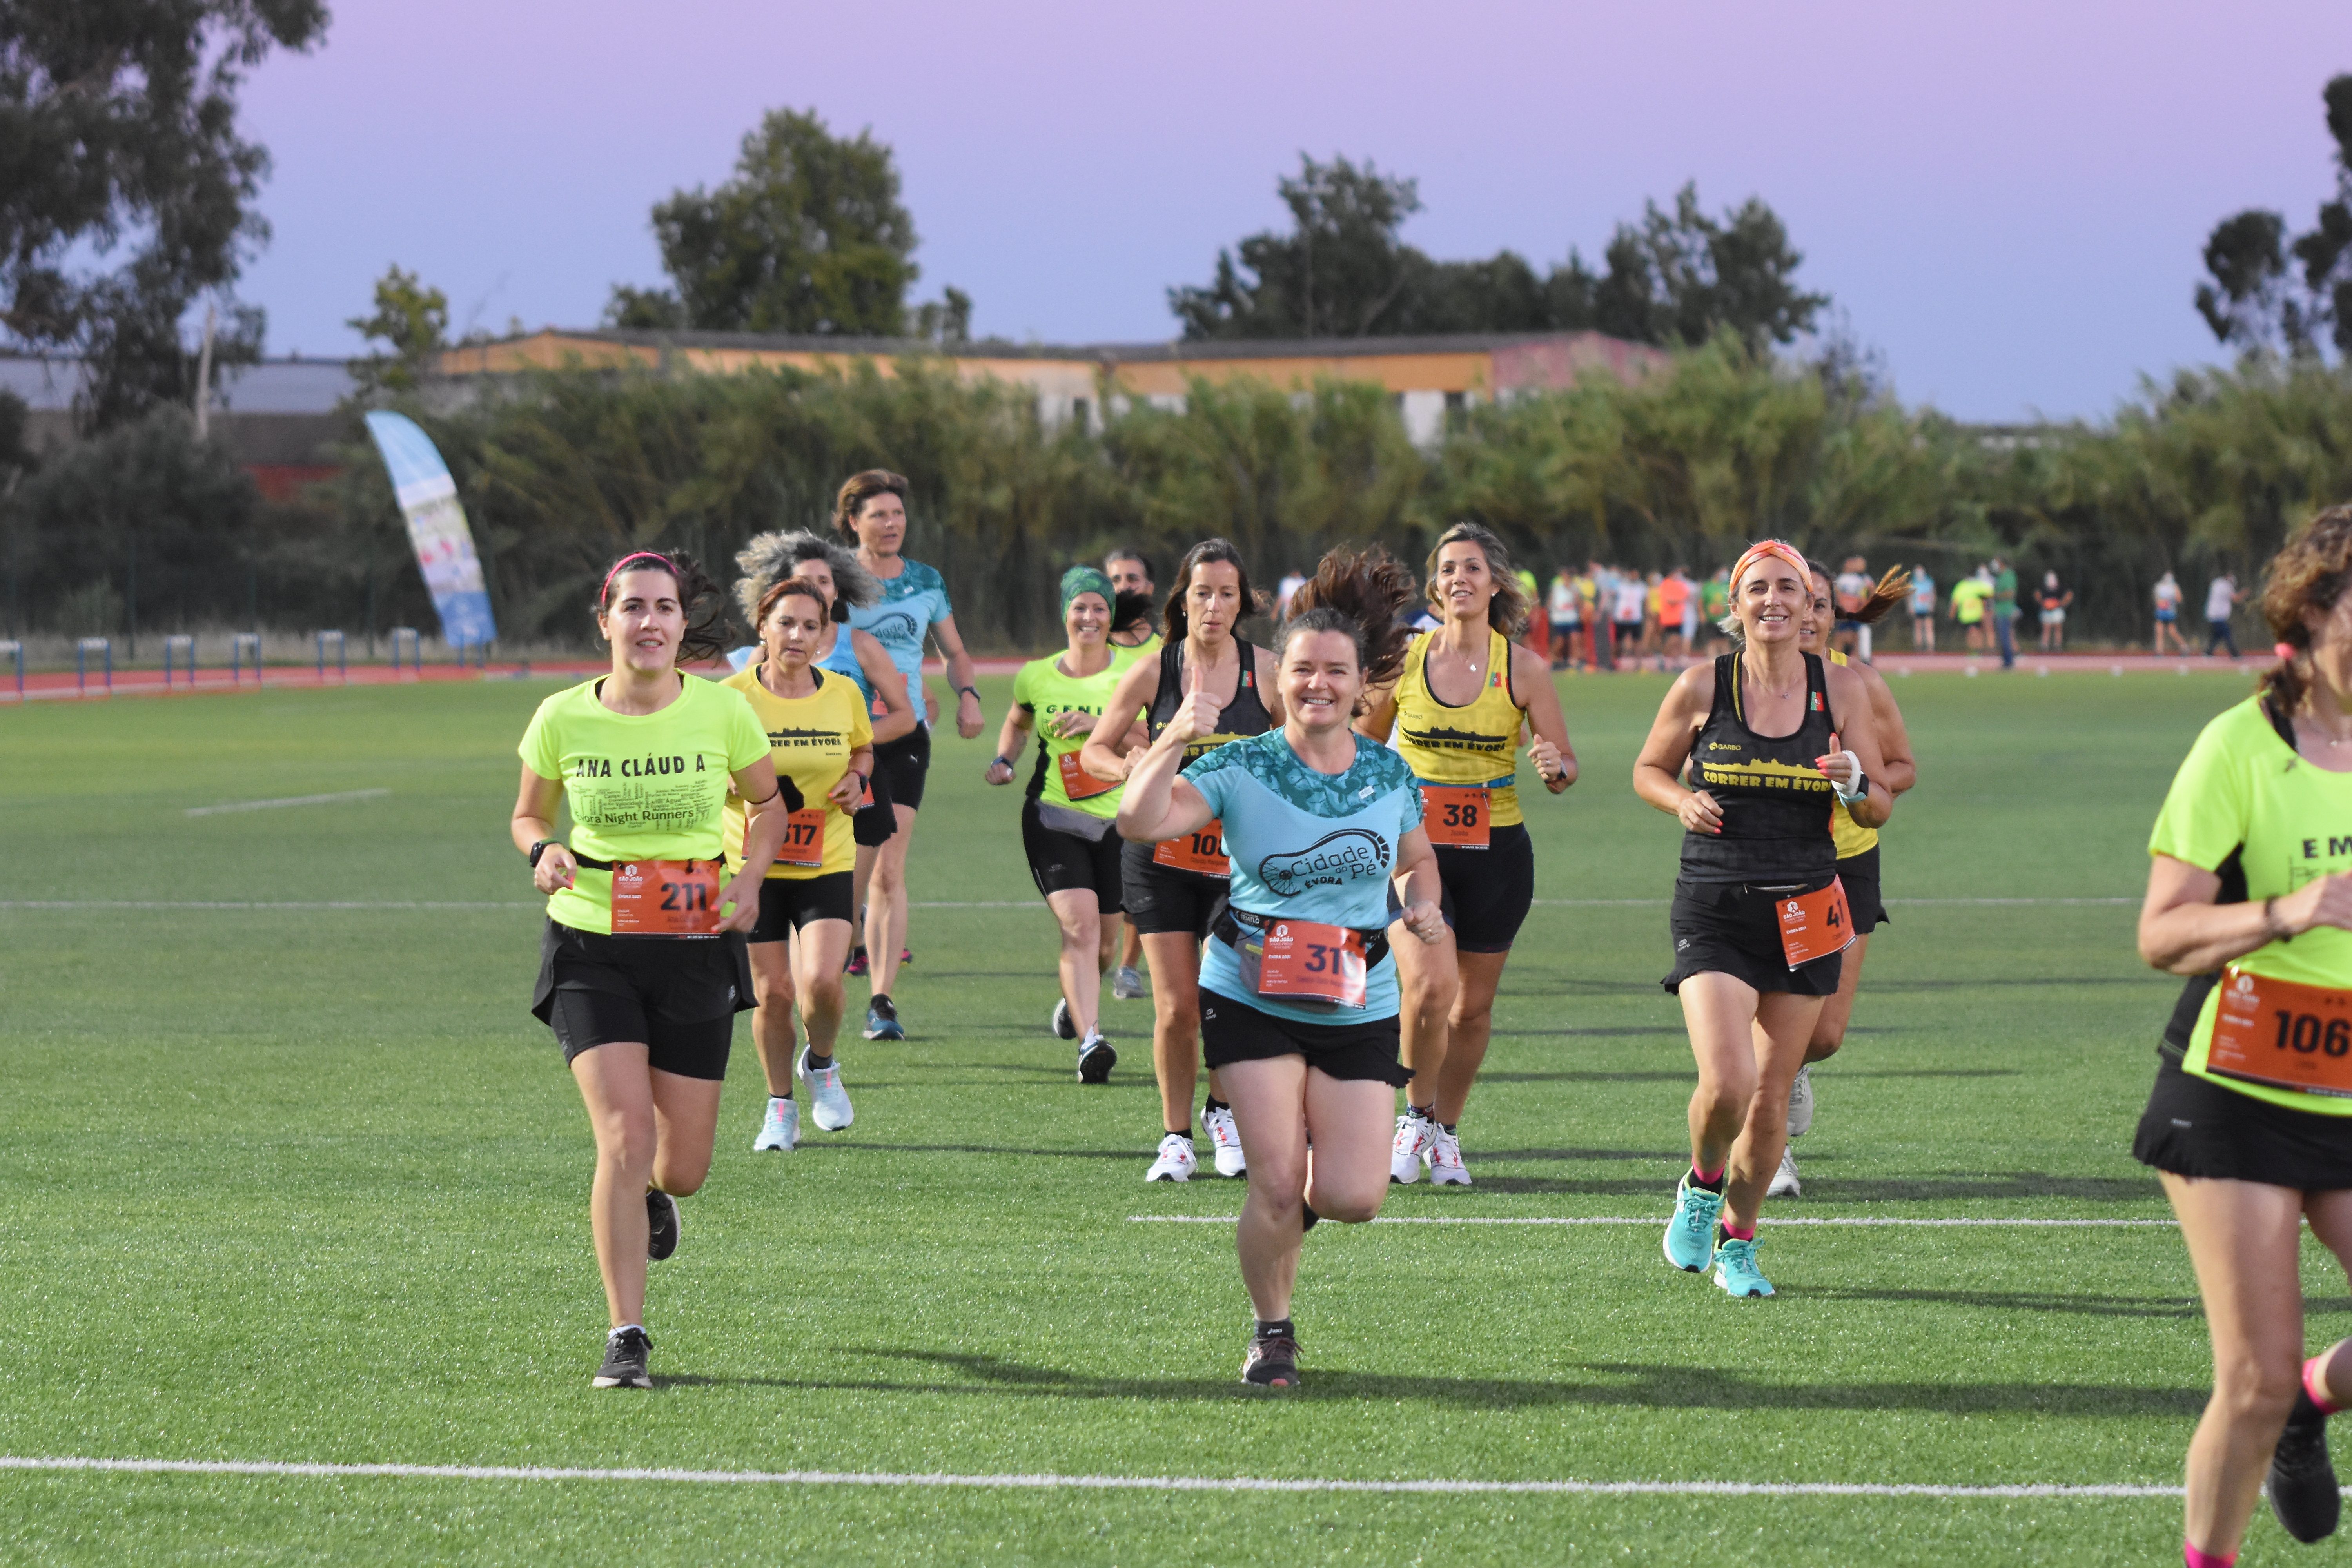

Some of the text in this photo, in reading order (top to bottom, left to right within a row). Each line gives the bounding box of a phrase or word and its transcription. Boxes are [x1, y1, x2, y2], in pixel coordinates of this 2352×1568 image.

[811, 737, 842, 746] ÉVORA
[576, 759, 612, 777] ANA
[1704, 771, 1761, 787] CORRER
[1766, 776, 1789, 789] EM
[605, 812, 638, 824] Night
[643, 810, 693, 820] Runners
[1443, 804, 1477, 827] 38
[1291, 846, 1369, 877] Cidade
[1351, 858, 1376, 879] Pé
[660, 882, 706, 911] 211
[1827, 899, 1844, 928] 41
[2276, 1010, 2350, 1058] 106
